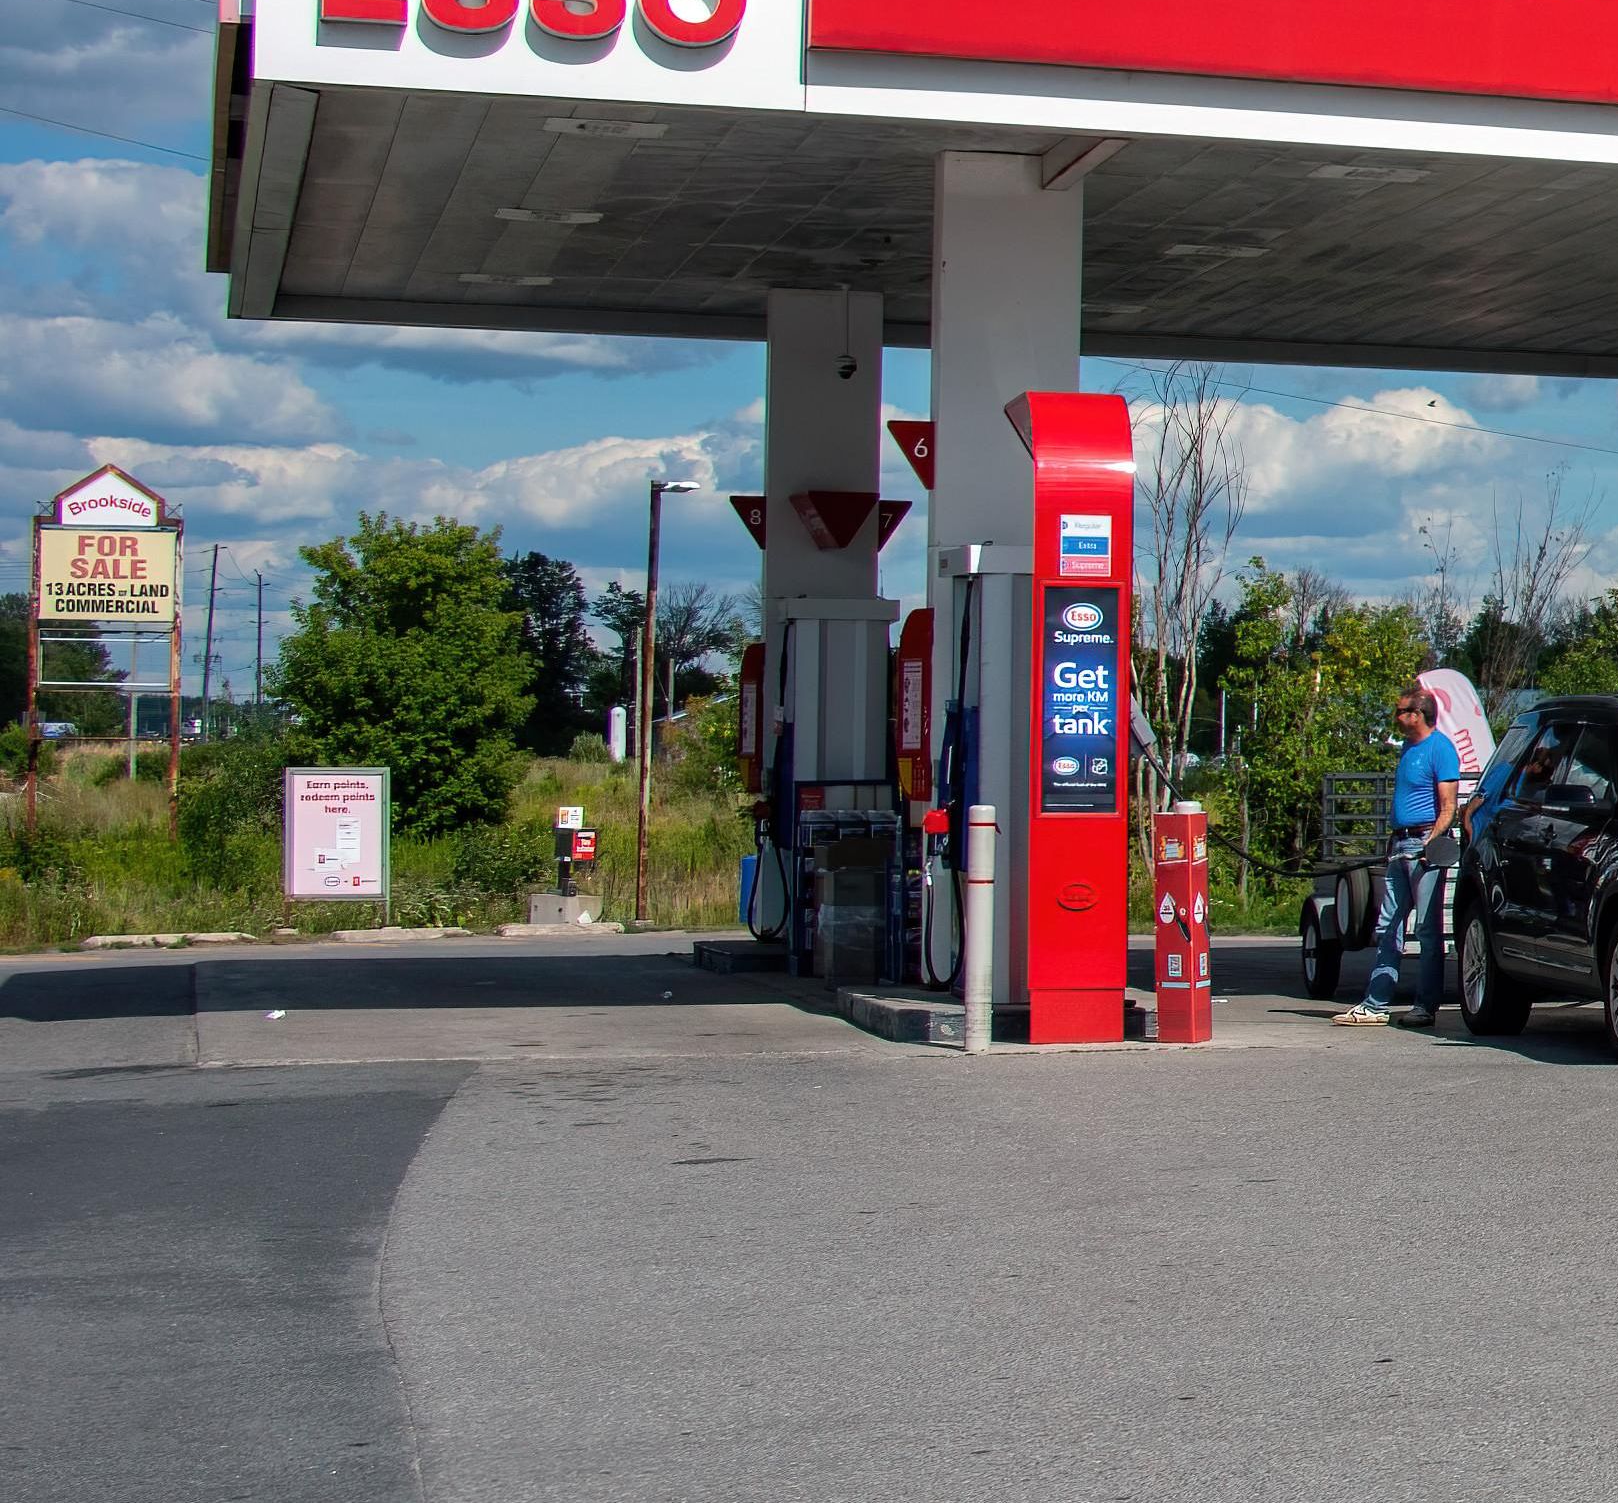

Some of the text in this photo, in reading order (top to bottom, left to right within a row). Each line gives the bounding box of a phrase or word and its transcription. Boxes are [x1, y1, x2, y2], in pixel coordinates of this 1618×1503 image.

[914, 438, 928, 458] 6
[67, 495, 152, 518] Brookside
[749, 509, 761, 525] 8
[881, 513, 893, 528] 7
[78, 535, 138, 557] FOR
[70, 558, 148, 579] SALE
[46, 582, 64, 596] 13
[66, 582, 116, 597] ACRES
[130, 584, 169, 598] LAND
[55, 598, 159, 614] COMMERCIAL
[1071, 610, 1097, 622] Esso
[1053, 661, 1109, 689] Get
[1053, 691, 1108, 703] more KM
[1053, 711, 1110, 735] tank
[306, 780, 331, 790] Earn
[300, 791, 376, 804] redeem points
[324, 804, 351, 814] here.
